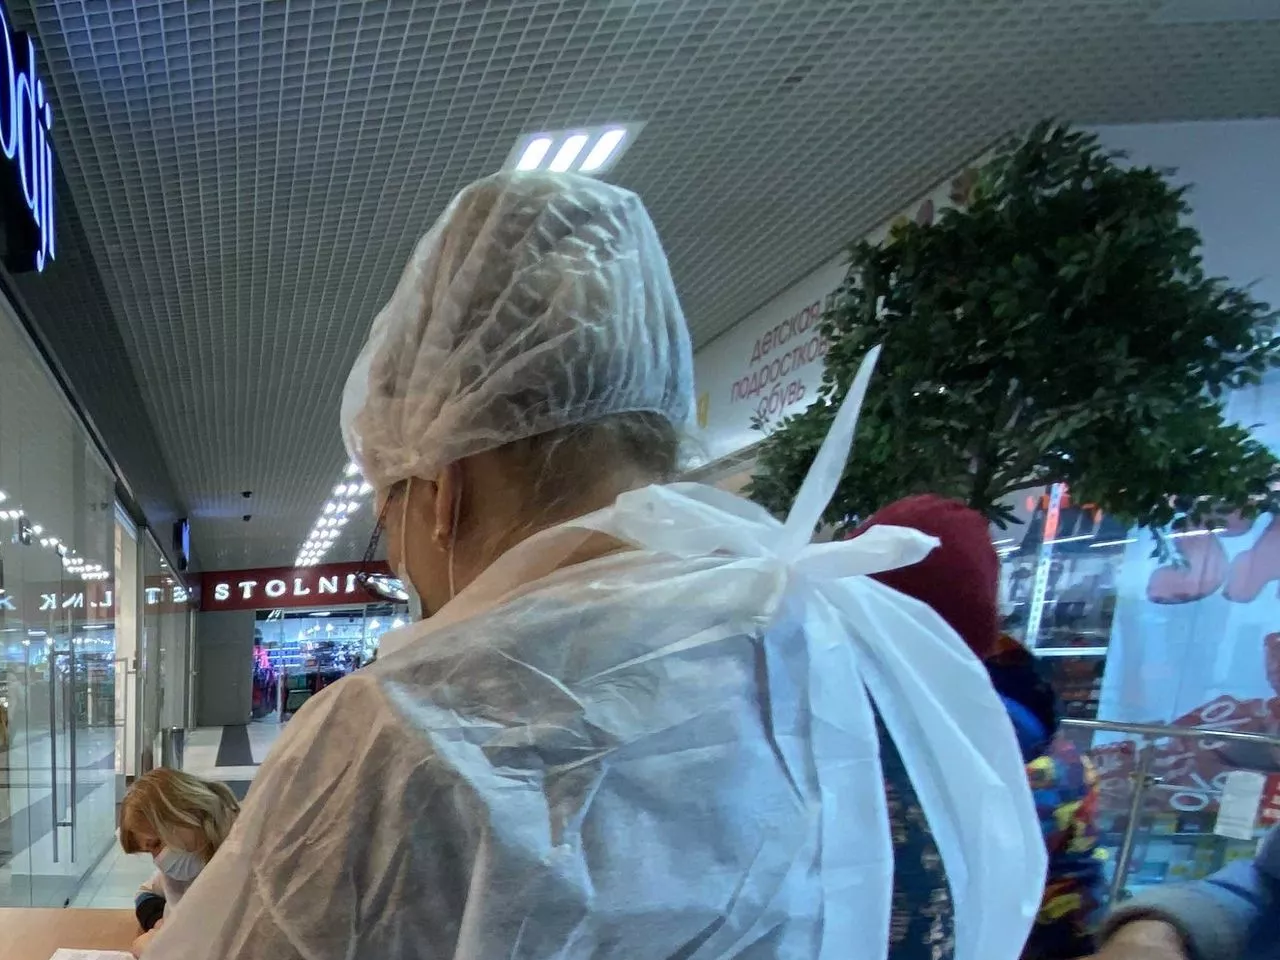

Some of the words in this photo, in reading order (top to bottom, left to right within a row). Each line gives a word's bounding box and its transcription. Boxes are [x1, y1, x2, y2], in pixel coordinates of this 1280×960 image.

[730, 334, 832, 403] подростков
[754, 377, 806, 420] обувь
[214, 573, 357, 600] STOLNI
